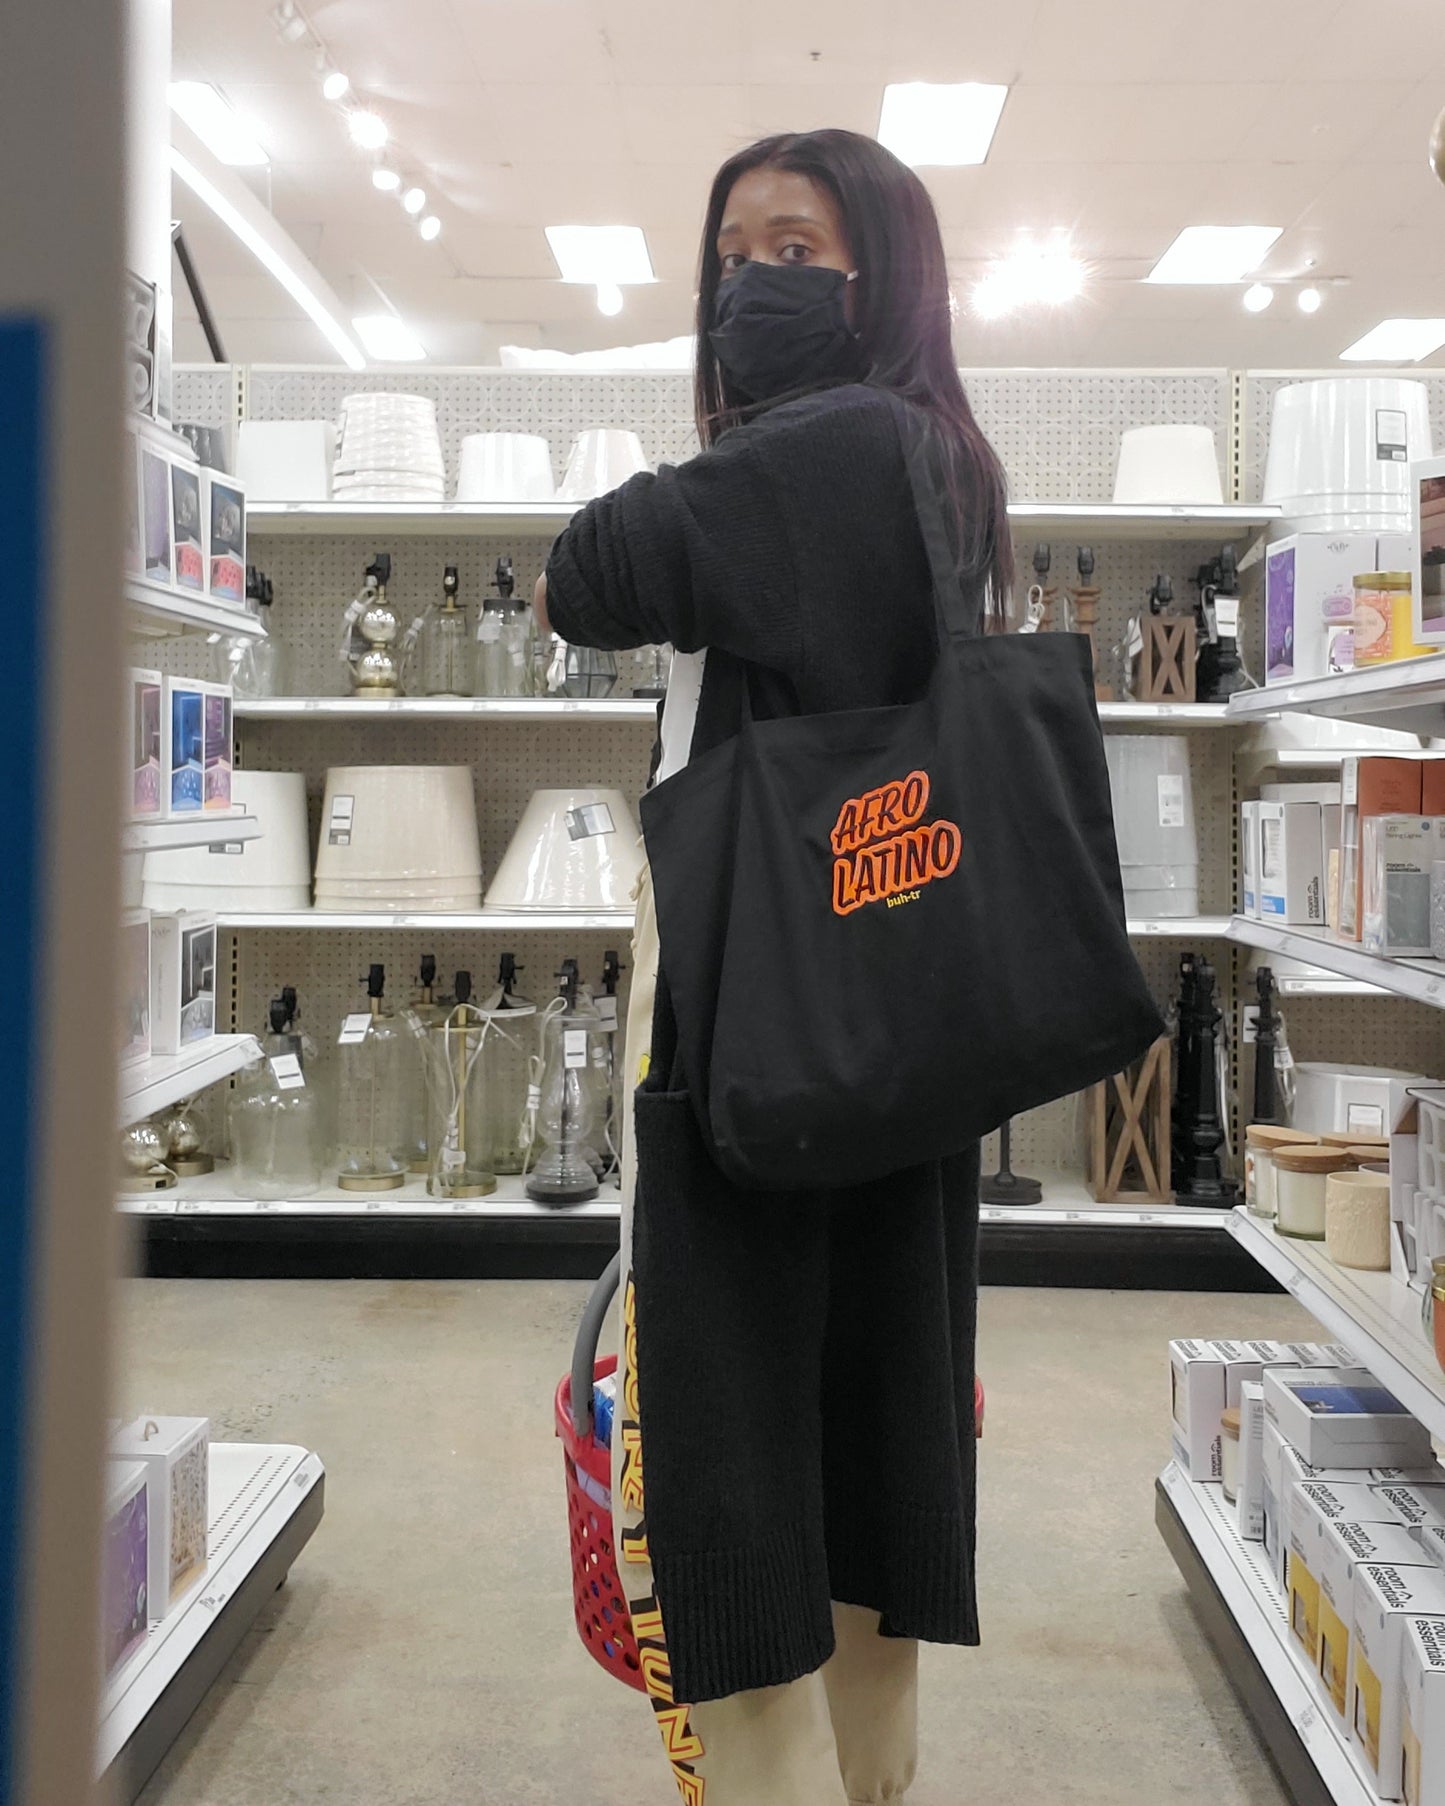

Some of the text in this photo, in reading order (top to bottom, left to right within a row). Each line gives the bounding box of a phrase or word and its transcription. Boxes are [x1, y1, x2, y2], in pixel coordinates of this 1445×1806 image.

[832, 771, 930, 854] AFRO
[833, 820, 961, 914] LATINO
[886, 889, 921, 908] buh-tr
[1301, 1483, 1339, 1518] essentials
[1314, 1484, 1339, 1503] room
[1382, 1488, 1422, 1523] essentials
[1394, 1488, 1421, 1508] room
[1333, 1521, 1370, 1559] essentials
[1347, 1522, 1371, 1543] room
[1367, 1566, 1405, 1609] essentials
[1381, 1566, 1407, 1590] room
[1415, 1620, 1445, 1667] essentials
